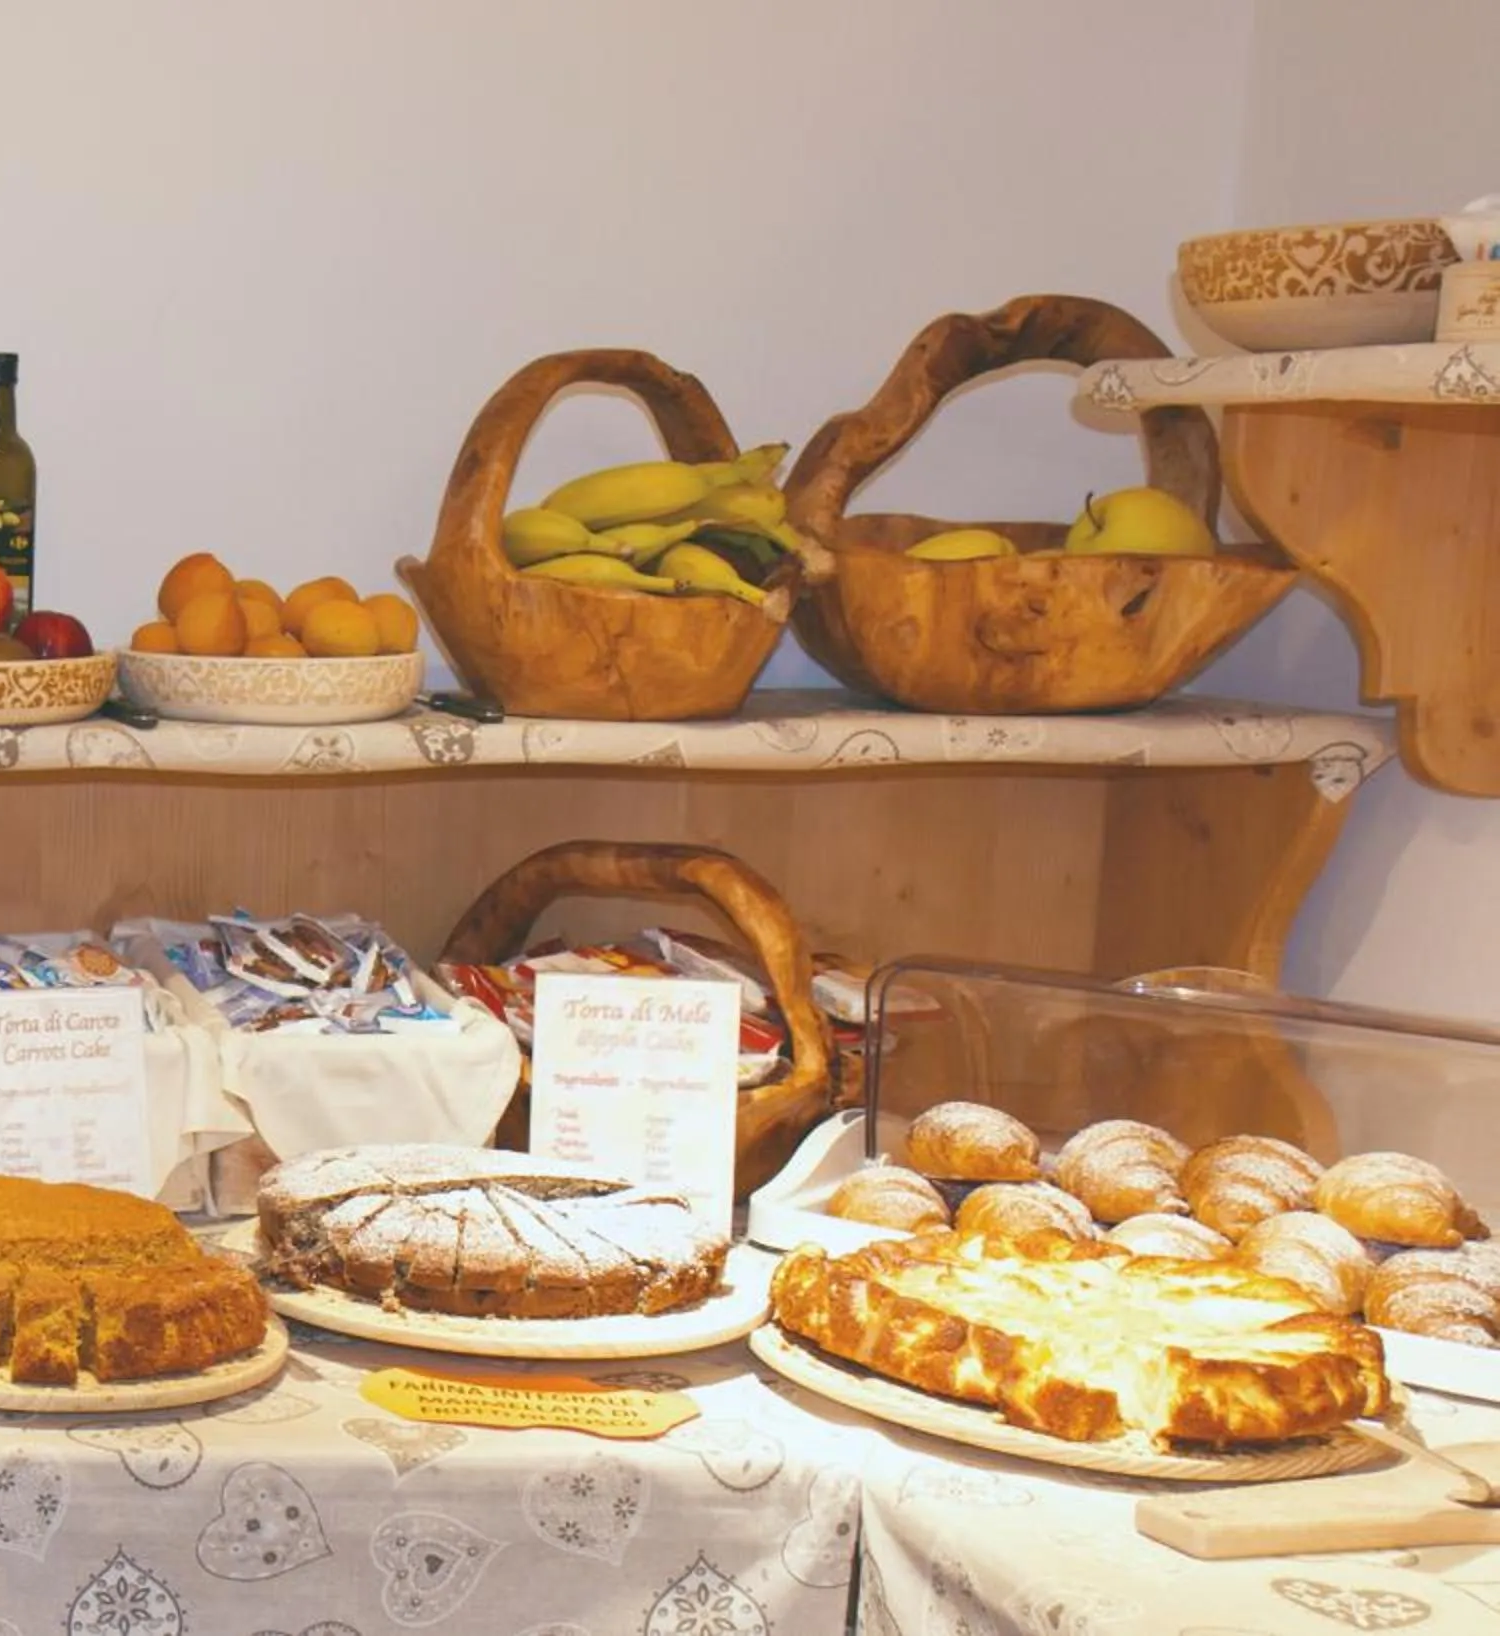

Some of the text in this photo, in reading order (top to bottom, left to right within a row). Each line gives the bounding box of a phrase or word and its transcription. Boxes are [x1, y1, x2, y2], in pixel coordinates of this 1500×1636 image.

[44, 1010, 62, 1032] di
[563, 995, 713, 1025] Torta di Mele
[388, 1379, 485, 1397] FARINA
[491, 1388, 631, 1407] INTEGRALE
[418, 1394, 605, 1417] MARMELLATA
